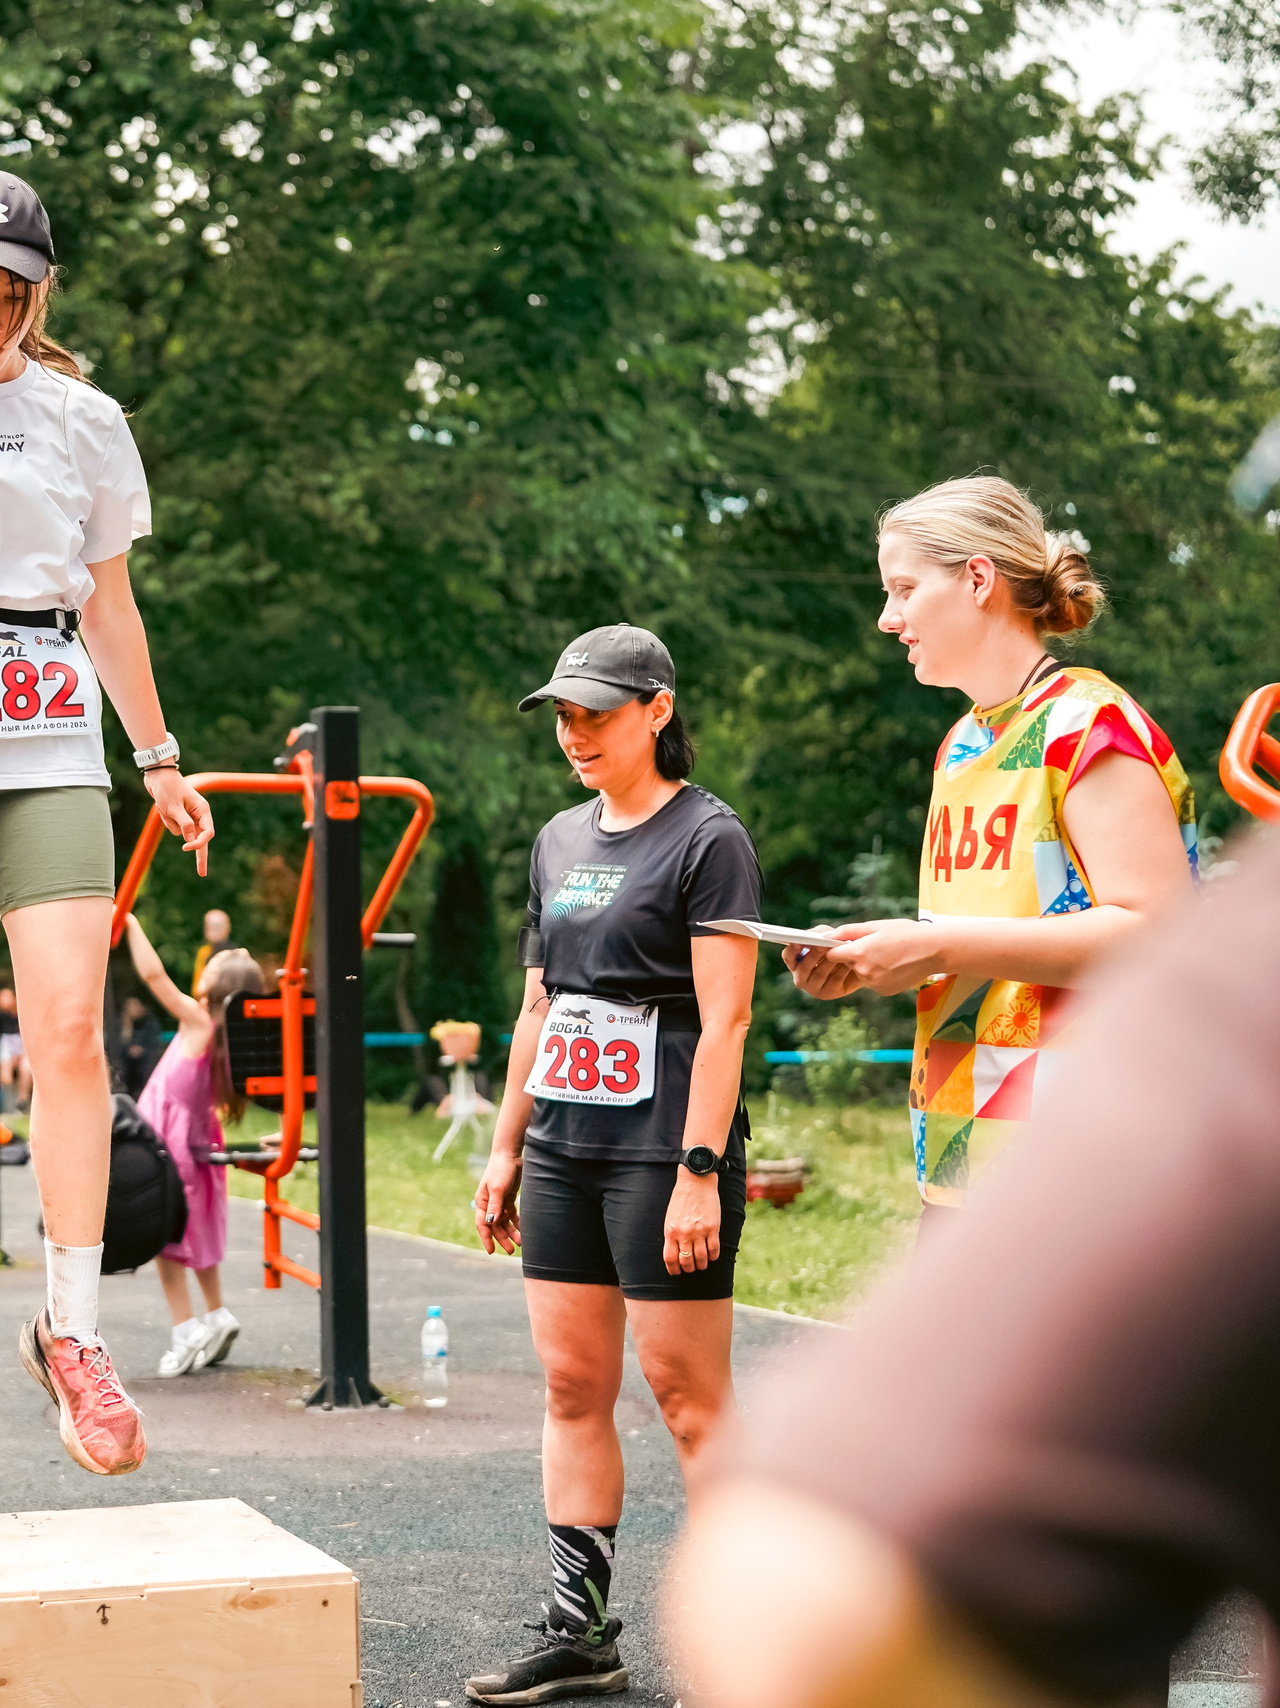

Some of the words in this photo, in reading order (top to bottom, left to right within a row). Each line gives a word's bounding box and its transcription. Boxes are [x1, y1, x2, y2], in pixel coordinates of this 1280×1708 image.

[22, 722, 69, 732] МАРАФОН
[928, 803, 1018, 883] УДЬЯ
[563, 871, 595, 887] RUN
[593, 873, 625, 890] THE
[553, 887, 615, 907] DISTANCE
[549, 1022, 593, 1036] BOGAL
[540, 1034, 640, 1094] 283
[581, 1095, 624, 1103] МАРАФОН
